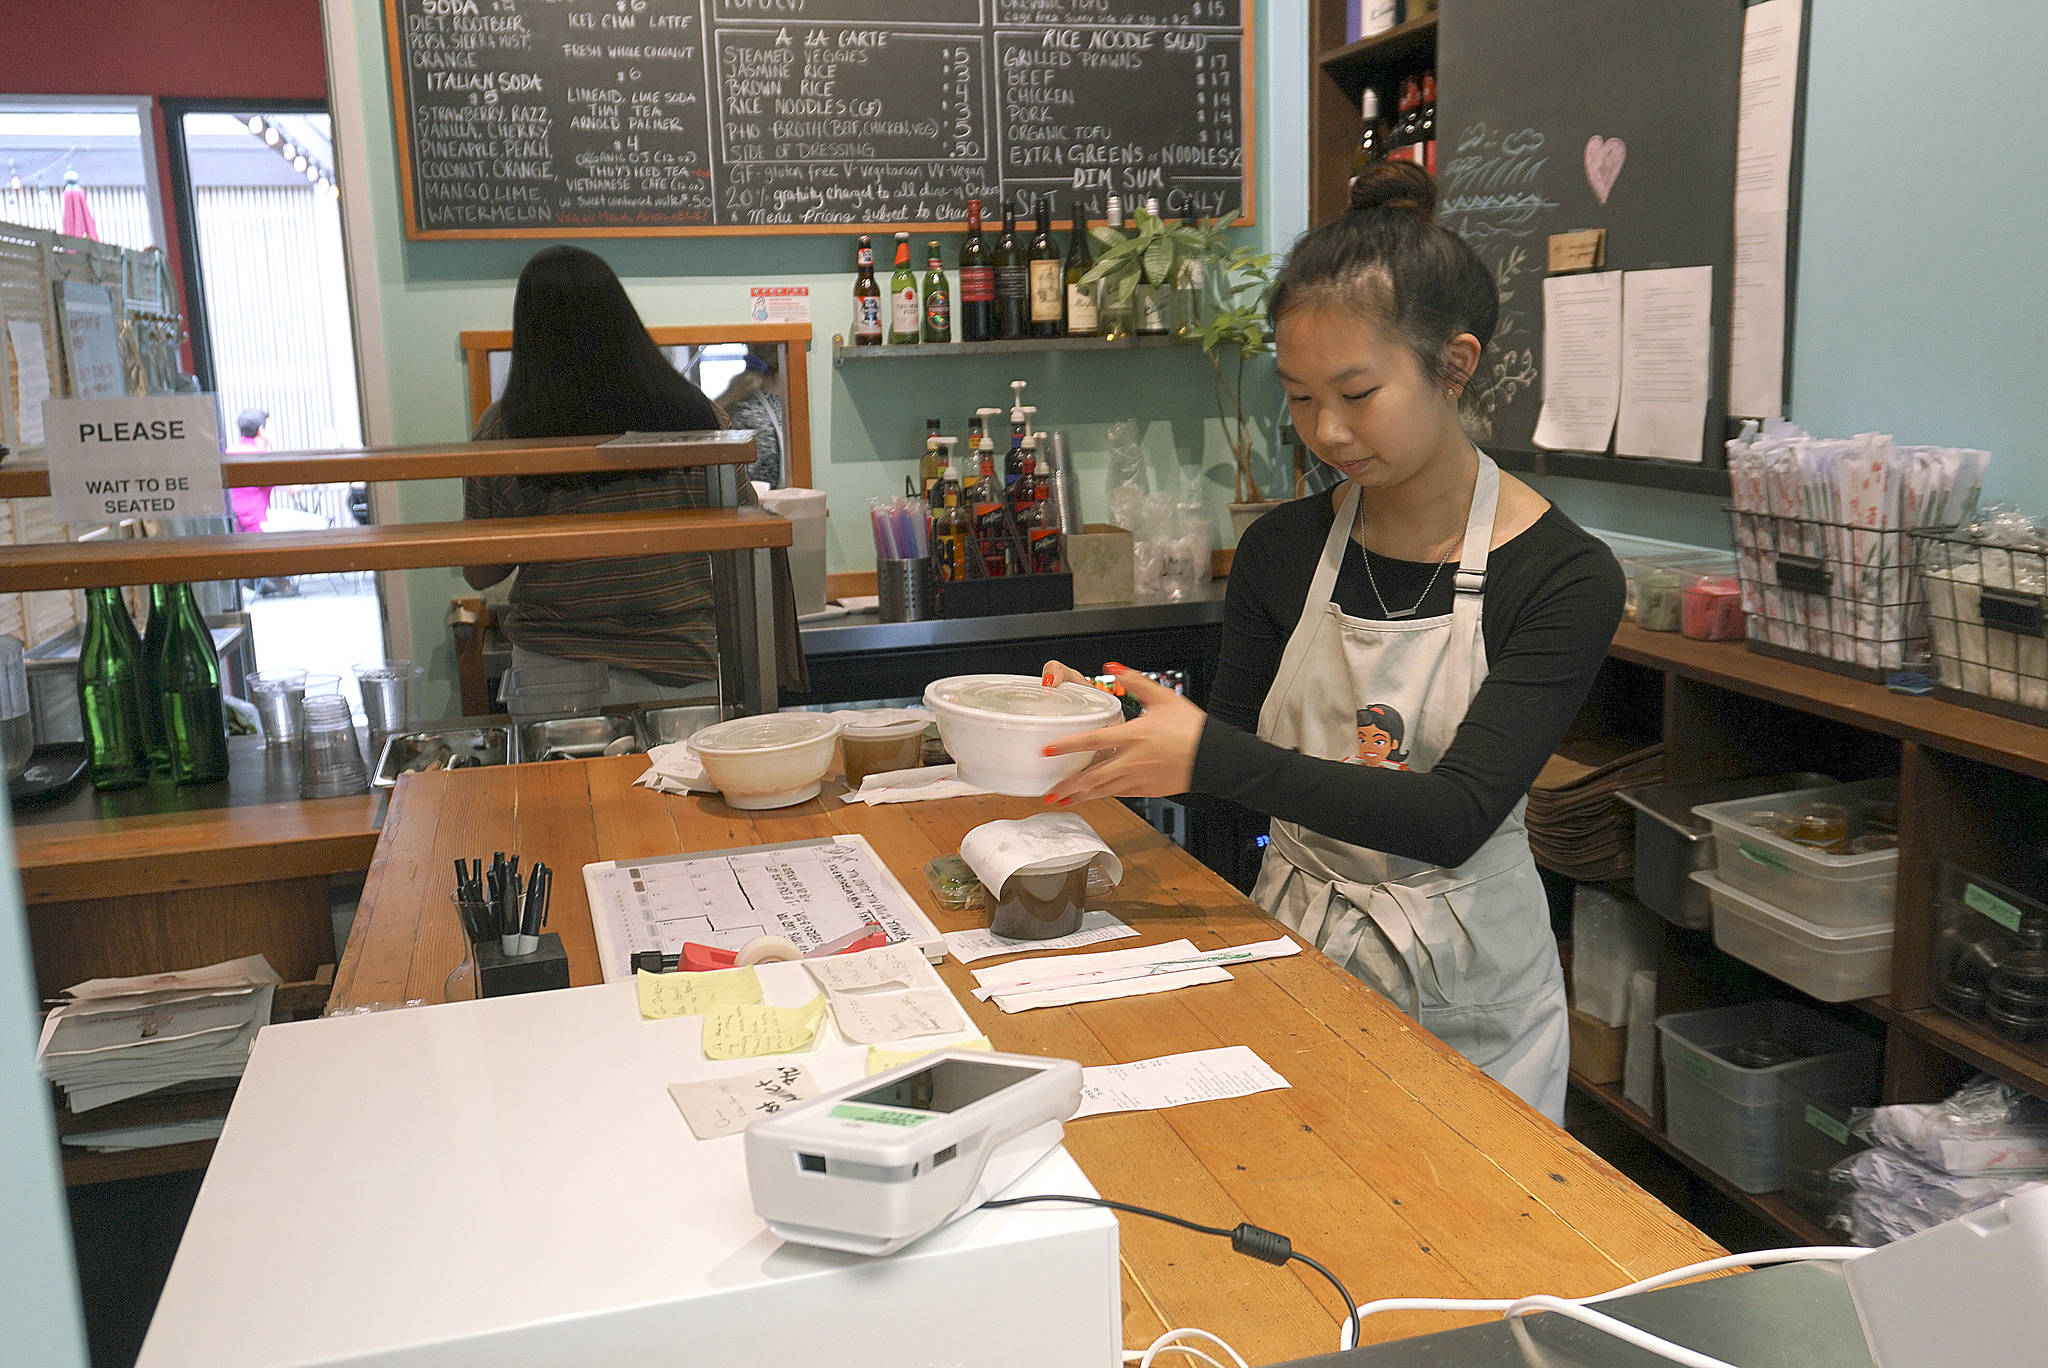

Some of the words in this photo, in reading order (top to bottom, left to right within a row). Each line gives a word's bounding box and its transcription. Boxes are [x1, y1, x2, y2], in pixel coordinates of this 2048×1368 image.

[569, 11, 596, 29] ICED
[602, 13, 637, 29] CHAI
[649, 15, 693, 29] LATTE
[774, 26, 793, 46] A
[803, 28, 830, 47] LA
[838, 29, 889, 48] CARTE
[1041, 28, 1081, 49] RICE
[1088, 30, 1157, 50] NOODLE
[1163, 31, 1208, 52] SALAD
[413, 50, 478, 68] ORANGE
[562, 43, 601, 58] FRESH
[607, 45, 641, 58] WHOLE
[644, 46, 695, 59] COCONUT
[723, 45, 795, 64] STEAMED
[804, 48, 869, 63] VEGGIES
[1003, 46, 1072, 67] GRILLED
[1078, 51, 1143, 69] PRAWNS
[725, 63, 791, 79] JASMINE
[803, 63, 838, 78] RICE
[1003, 68, 1056, 86] BEEF
[427, 71, 494, 91] ITALIAN
[498, 71, 543, 92] SODA
[725, 78, 782, 96] BROWN
[799, 78, 835, 96] RICE
[631, 90, 660, 104] LIME
[664, 88, 697, 104] SODA
[1007, 87, 1075, 104] CHICKEN
[418, 104, 507, 122] STRAWBERRY,
[511, 104, 552, 125] RAZZ,
[588, 103, 619, 118] THAI
[632, 104, 662, 118] TEA
[725, 96, 762, 115] RICE
[775, 97, 847, 115] NOODLES
[1005, 104, 1054, 122] PORK
[569, 115, 621, 130] ARNOLD
[627, 116, 684, 130] PALMER
[725, 121, 761, 141] PHO
[1008, 123, 1071, 141] ORGANIC
[1074, 125, 1112, 140] TOFU
[575, 150, 626, 167] ORGANIC
[729, 143, 767, 161] SIDE
[775, 142, 792, 160] OF
[796, 141, 875, 159] DRESSING
[1010, 145, 1064, 167] EXTRA
[1067, 143, 1144, 165] GREENS
[1161, 144, 1229, 166] NOODLES
[634, 166, 660, 178] ICED
[662, 165, 690, 178] TEA
[808, 164, 840, 182] free
[1073, 167, 1113, 190] DIM
[1120, 166, 1165, 189] SUM
[565, 178, 631, 192] VIETNAMESE
[773, 186, 825, 210] gratuity
[876, 183, 890, 200] to
[893, 181, 917, 197] all
[1013, 188, 1058, 218] SAT
[427, 205, 551, 223] WATERMELON
[747, 209, 793, 224] Menu
[862, 203, 910, 223] subject
[913, 200, 931, 220] to
[79, 421, 185, 442] PLEASE
[86, 480, 130, 494] WAIT
[136, 479, 159, 492] TO
[166, 477, 190, 491] BE
[104, 499, 176, 514] SEATED
